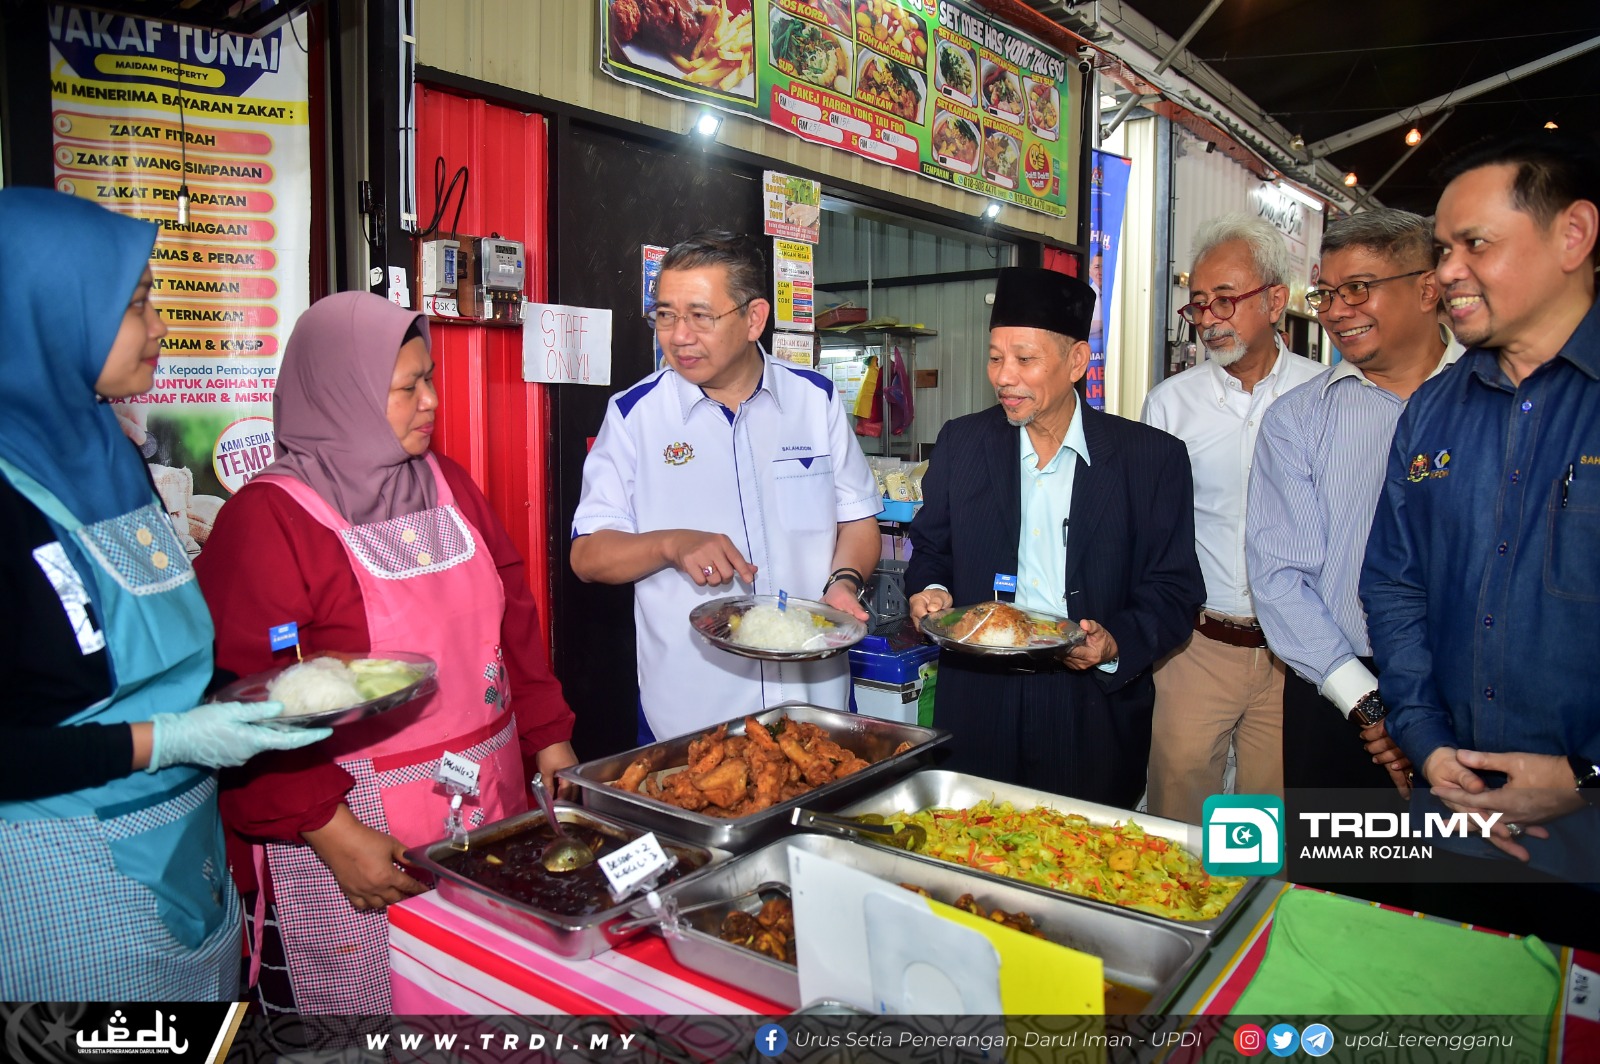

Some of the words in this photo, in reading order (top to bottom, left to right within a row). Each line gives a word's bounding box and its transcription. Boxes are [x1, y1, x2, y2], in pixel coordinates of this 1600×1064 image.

[800, 3, 828, 24] KOREA
[938, 28, 951, 39] SET
[950, 33, 973, 50] BAKSO
[939, 1, 960, 31] SET
[961, 12, 984, 46] MEE
[1004, 36, 1033, 69] YONG
[1029, 50, 1051, 76] TAU
[173, 25, 281, 72] TUNAI
[890, 45, 912, 64] ODEN
[115, 60, 158, 73] MAIDAM
[159, 65, 209, 81] PROPERTY
[778, 58, 794, 73] SUP
[51, 80, 68, 95] MI
[71, 83, 158, 105] MENERIMA
[162, 93, 233, 115] BAYARAN
[237, 103, 286, 119] ZAKAT
[791, 84, 820, 104] PAKEJ
[822, 96, 851, 115] HARGA
[853, 104, 873, 123] YONG
[875, 115, 889, 128] TAU
[857, 90, 875, 104] KARI
[875, 98, 893, 110] KAW
[937, 98, 948, 109] SET
[791, 116, 797, 127] 4
[798, 119, 808, 131] RM
[821, 111, 829, 121] 2
[983, 118, 993, 128] SET
[109, 124, 161, 140] ZAKAT
[165, 128, 216, 147] FITRAH
[851, 136, 858, 145] 5
[875, 129, 881, 139] 3
[76, 152, 129, 168] ZAKAT
[133, 156, 182, 172] WANG
[184, 160, 262, 179] SIMPANAN
[96, 186, 148, 200] ZAKAT
[153, 189, 247, 207] PENAPATAN
[155, 219, 248, 235] PERNIAGAAN
[193, 251, 203, 263] &
[208, 252, 255, 265] PERAK
[168, 280, 239, 293] TANAMAN
[395, 274, 401, 284] 3
[426, 300, 450, 312] KOSK
[451, 303, 456, 312] 2
[167, 309, 244, 322] TERNAKAN
[540, 309, 589, 350] STAFF
[160, 338, 201, 350] AHAM
[205, 339, 216, 350] &
[221, 339, 263, 350] KWSP
[169, 364, 213, 378] Kepada
[216, 364, 276, 378] Pembayar
[155, 379, 202, 390] UNTUK
[206, 378, 258, 390] AGIHAN
[261, 378, 276, 389] TE
[129, 393, 177, 404] ASNAF
[180, 392, 217, 404] FAKIR
[220, 392, 231, 403] &
[235, 392, 273, 403] MISKI
[220, 439, 244, 453] KAMI
[245, 432, 271, 447] SEDIA
[217, 444, 275, 478] TEMP
[642, 843, 650, 852] 2
